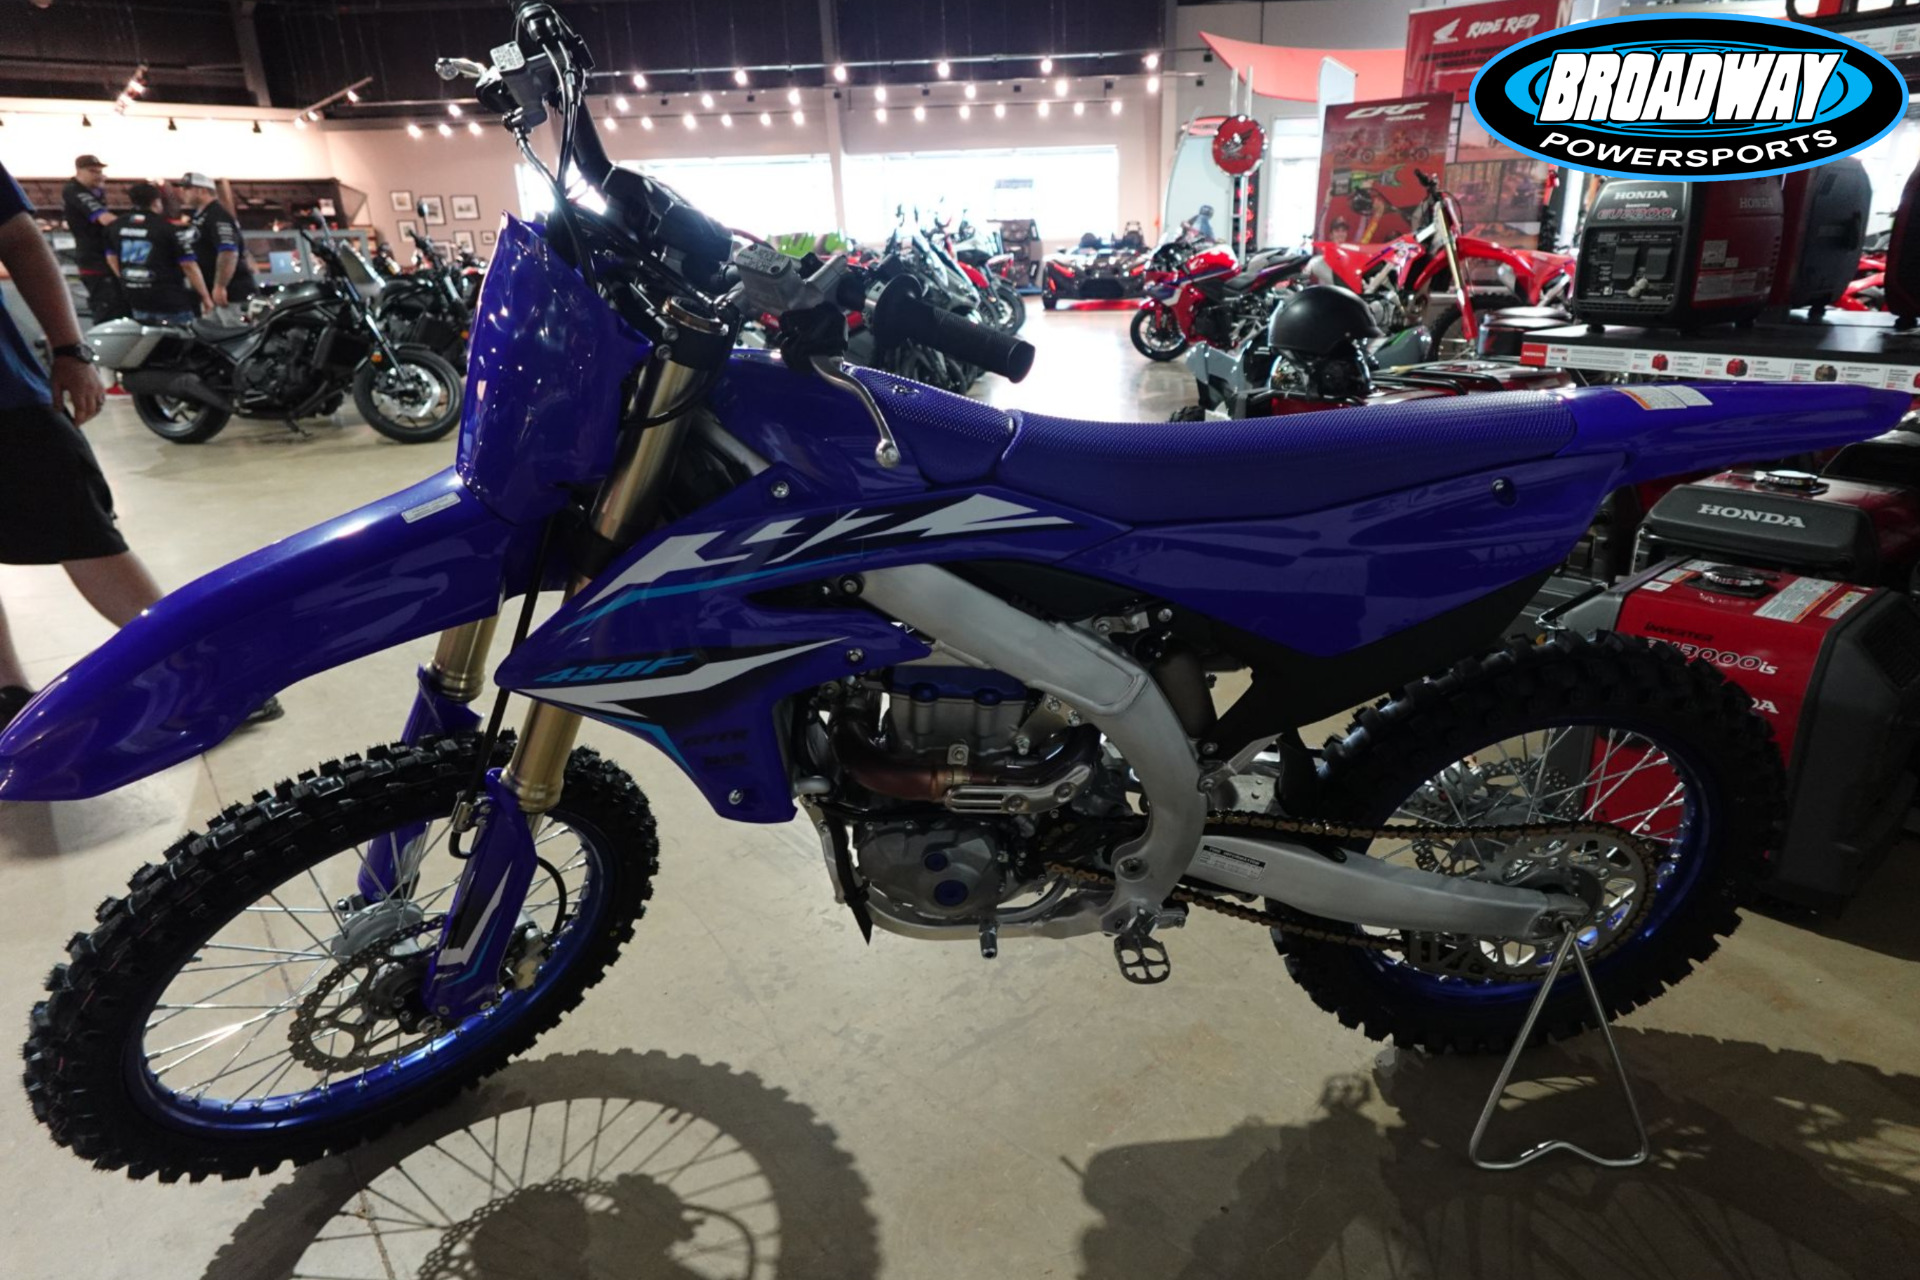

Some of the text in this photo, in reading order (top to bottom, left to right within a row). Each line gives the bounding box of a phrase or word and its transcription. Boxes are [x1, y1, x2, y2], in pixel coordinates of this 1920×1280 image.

[1465, 13, 1540, 38] RIDE RED
[1344, 101, 1430, 120] CRF
[1614, 190, 1669, 200] HONDA
[1697, 503, 1806, 528] HONDA
[1646, 636, 1779, 675] 3000is
[533, 654, 695, 683] 450F
